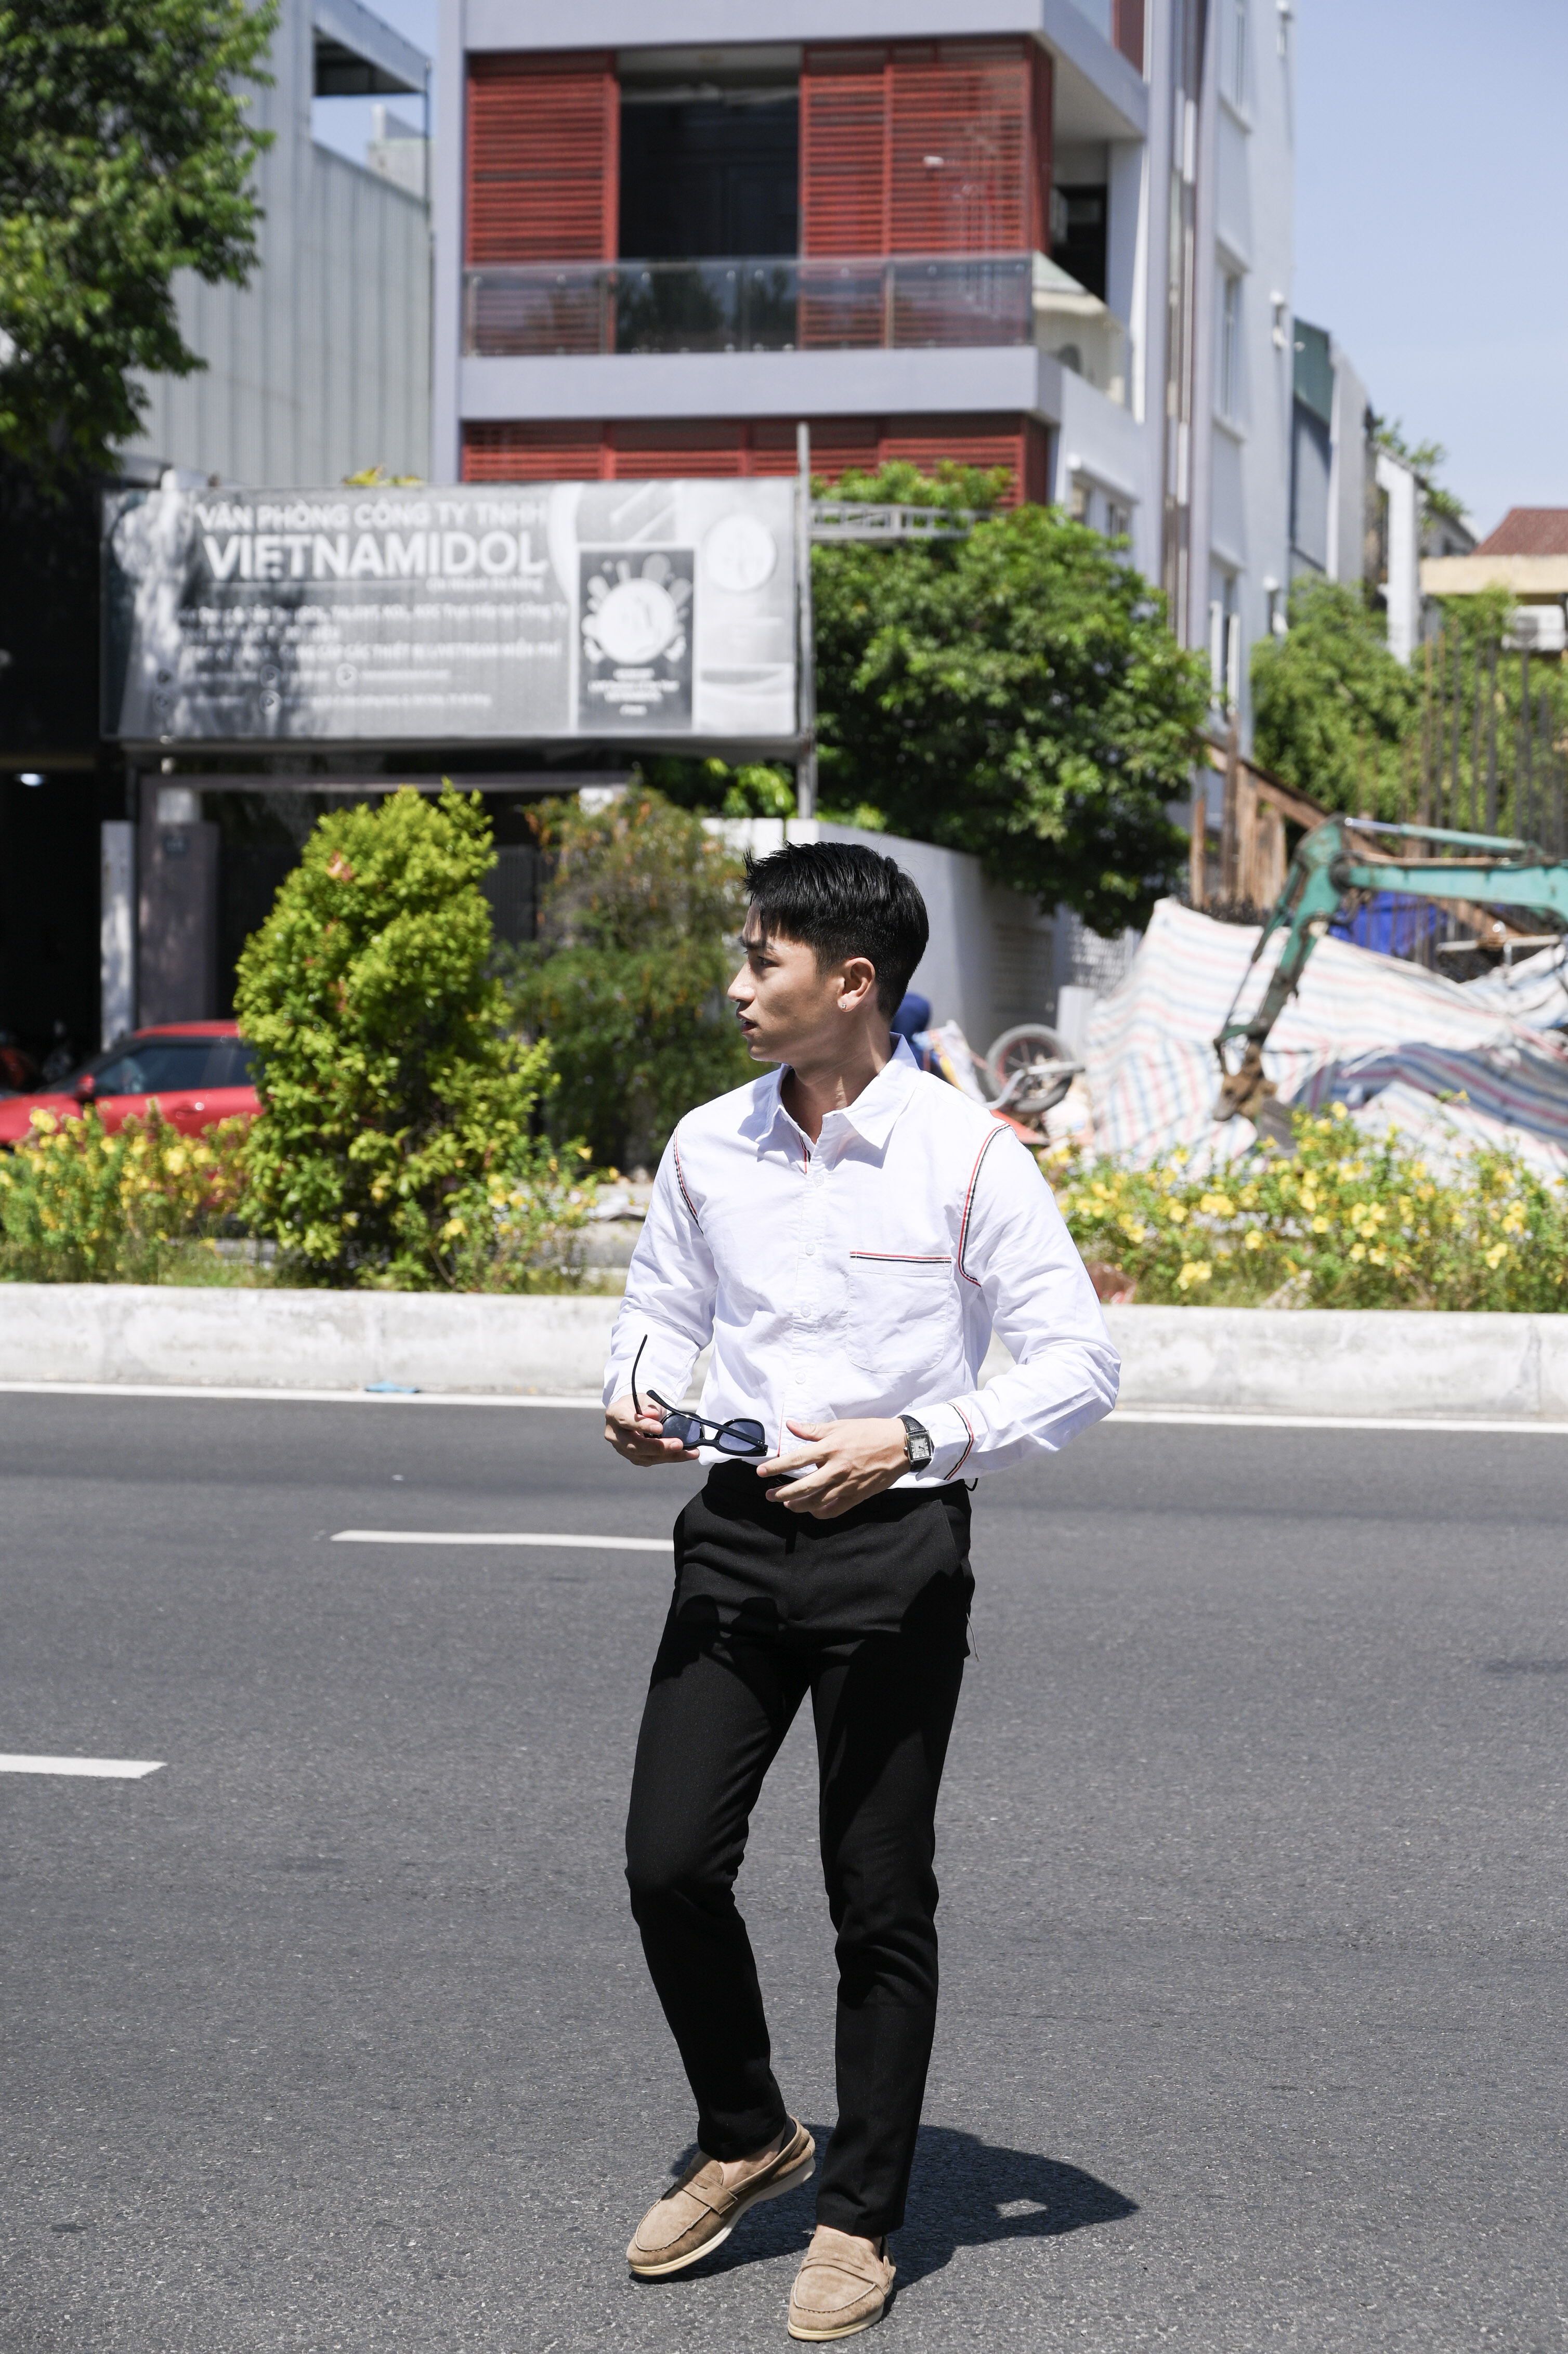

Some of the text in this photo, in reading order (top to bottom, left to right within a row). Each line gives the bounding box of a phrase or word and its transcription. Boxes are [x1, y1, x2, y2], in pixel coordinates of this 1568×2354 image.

[256, 499, 349, 530] PHÒNG
[354, 496, 431, 529] CÔNG
[434, 501, 467, 527] TY
[474, 501, 547, 527] TNHH
[203, 531, 548, 580] VIETNAMIDOL
